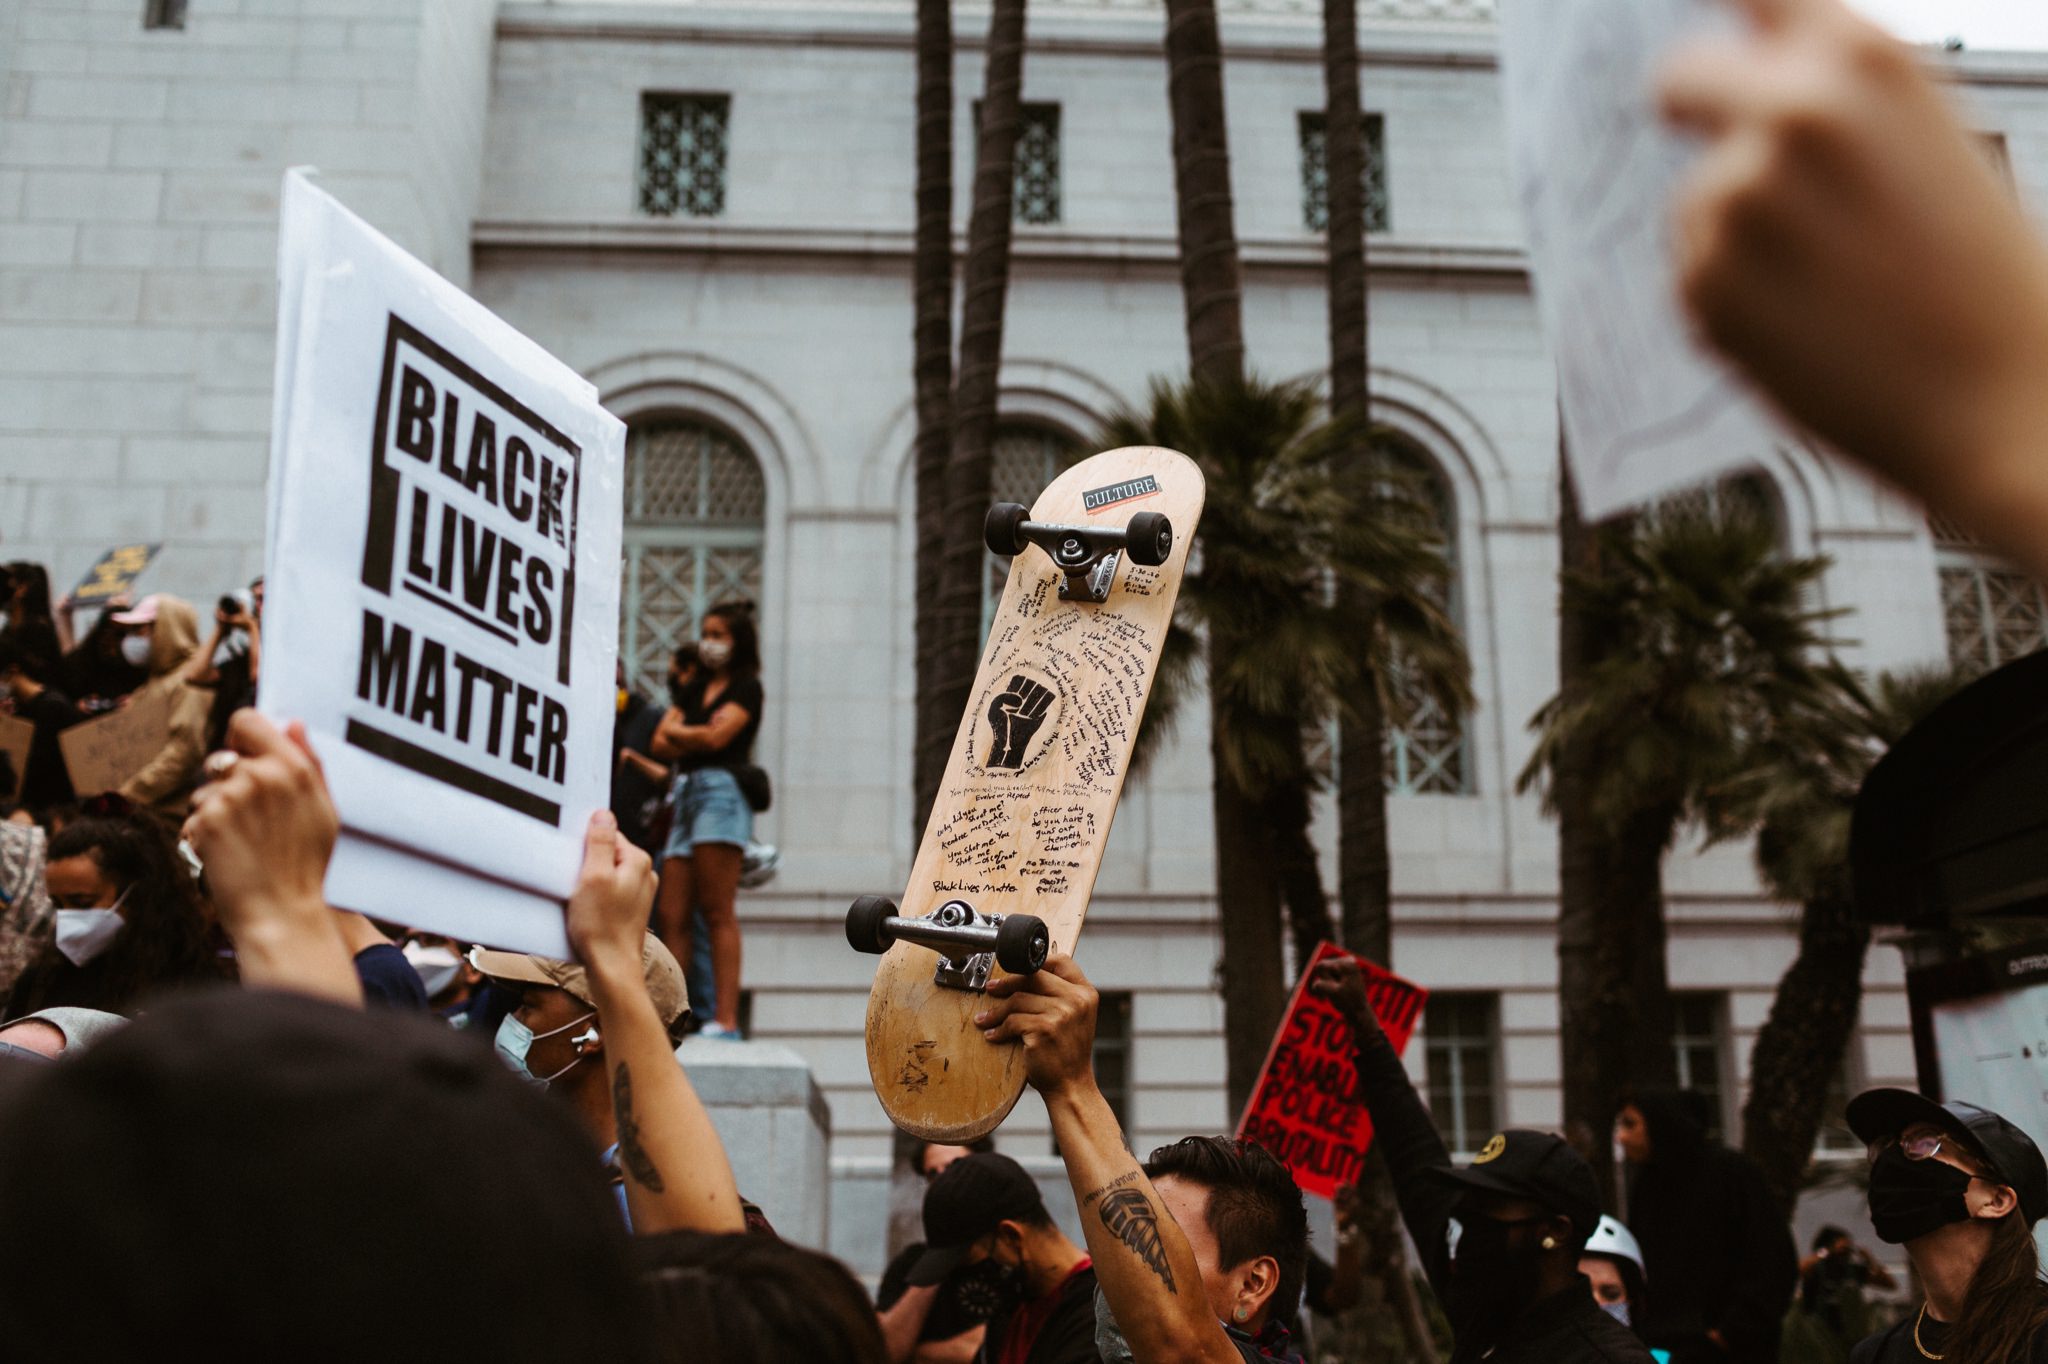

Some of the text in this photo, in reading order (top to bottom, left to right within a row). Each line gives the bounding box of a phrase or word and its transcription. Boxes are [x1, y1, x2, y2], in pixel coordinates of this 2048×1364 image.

[395, 363, 568, 549] BLACK
[1085, 478, 1156, 508] CULTURE
[408, 484, 553, 645] LIVES
[1037, 581, 1051, 607] Justice
[1121, 620, 1146, 637] reaching
[356, 608, 569, 785] MATTER
[1043, 731, 1060, 747] They
[975, 793, 996, 802] Evolve
[1006, 791, 1031, 802] Repeat
[952, 811, 964, 823] did
[962, 807, 977, 819] you
[1067, 804, 1084, 815] why
[1044, 819, 1060, 828] you
[1063, 815, 1083, 823] have
[995, 830, 1010, 840] You
[1035, 824, 1075, 840] guns out
[977, 848, 991, 858] me
[1260, 1079, 1360, 1140] POLICE
